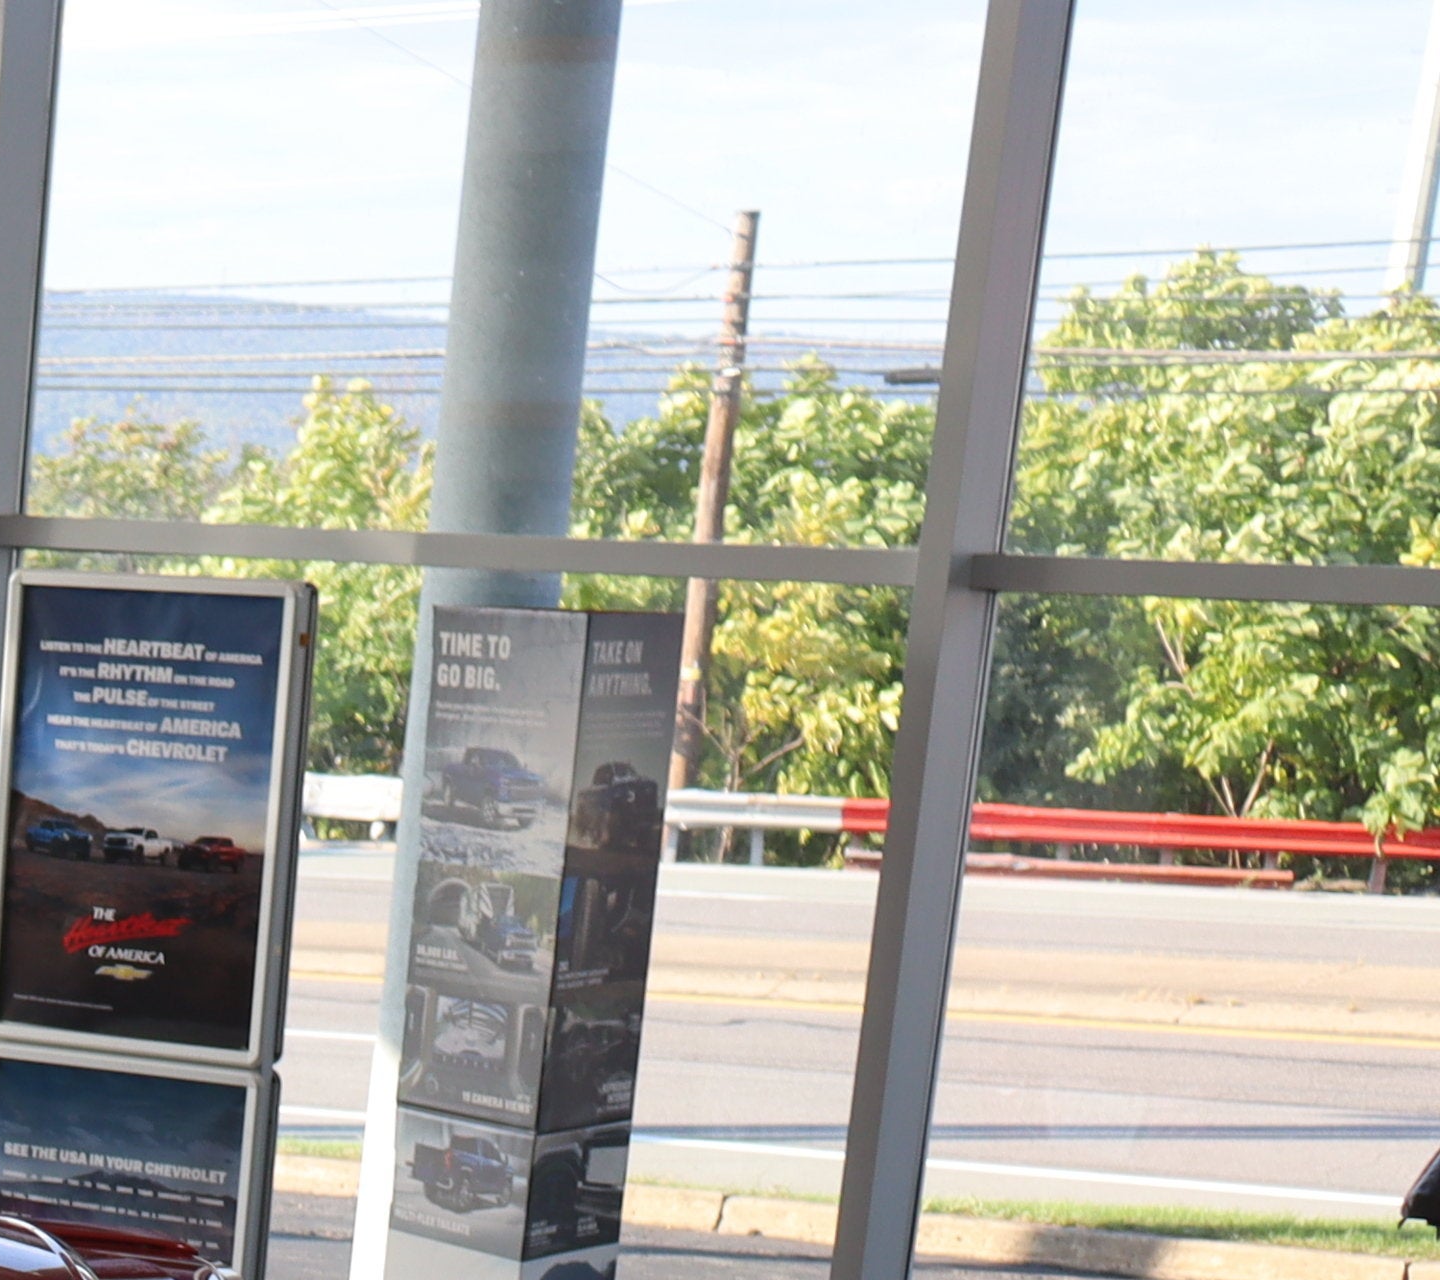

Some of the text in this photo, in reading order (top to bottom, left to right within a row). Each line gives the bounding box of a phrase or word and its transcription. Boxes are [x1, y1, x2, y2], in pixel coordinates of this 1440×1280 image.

[85, 643, 103, 653] THE
[103, 638, 205, 660] HEARTBEAT
[440, 631, 511, 659] TIME TO
[593, 641, 643, 664] TAKE ON
[97, 662, 173, 683] RHYTHM
[189, 676, 207, 686] THE
[437, 664, 501, 691] GO BIG.
[589, 672, 652, 696] ANYTHING.
[92, 687, 149, 706] PULSE
[160, 717, 242, 739] AMERICA
[126, 740, 227, 762] CHEVROLET
[93, 906, 116, 921] THE
[88, 945, 165, 965] OF AMERICA
[3, 1141, 227, 1184] SEE THE USA IN YOUR CHEVROLET
